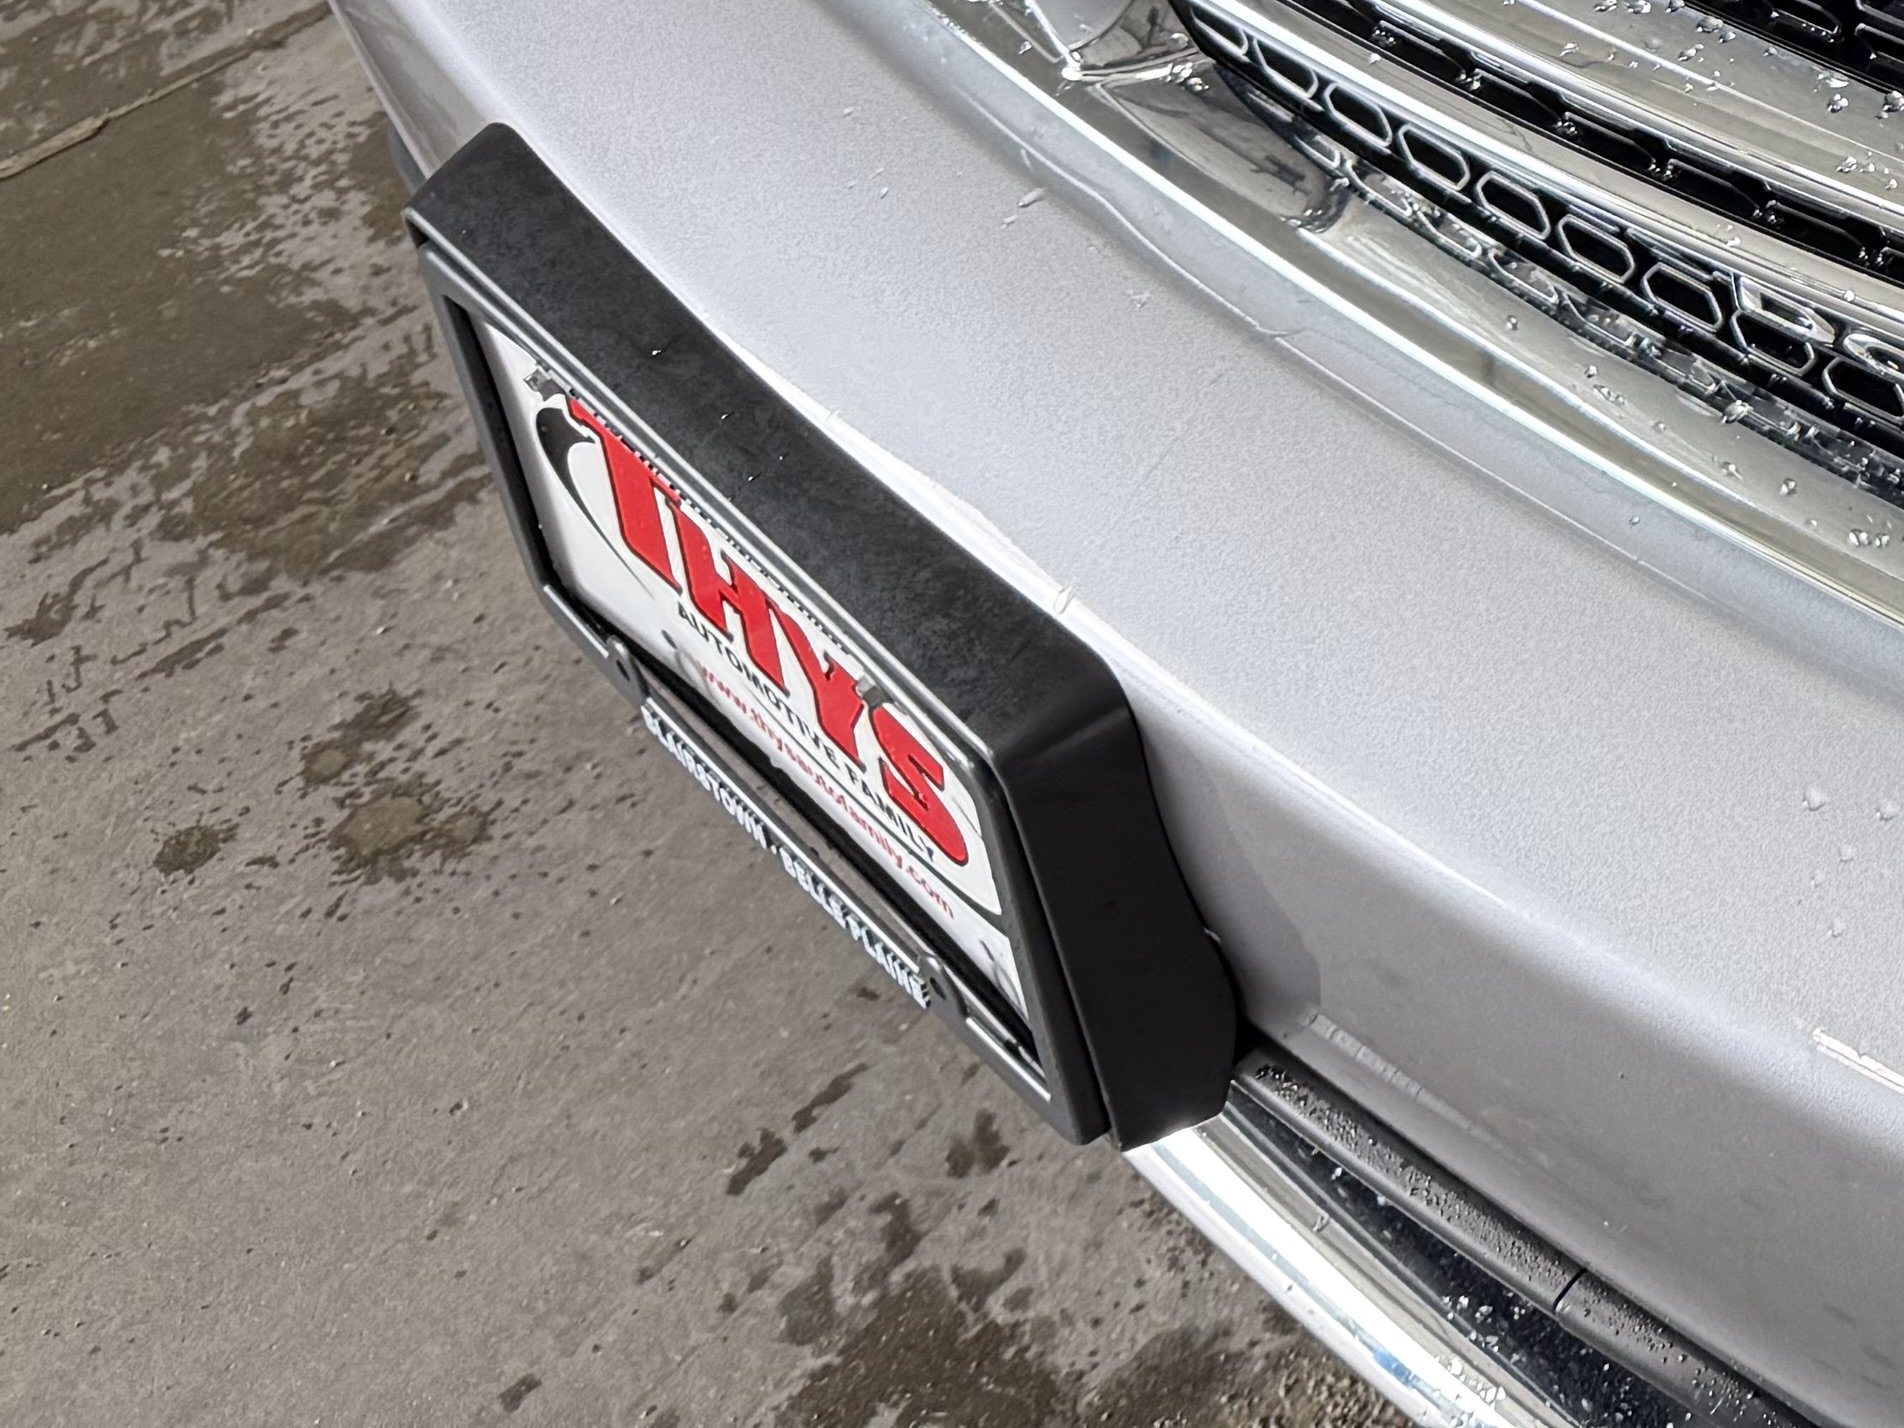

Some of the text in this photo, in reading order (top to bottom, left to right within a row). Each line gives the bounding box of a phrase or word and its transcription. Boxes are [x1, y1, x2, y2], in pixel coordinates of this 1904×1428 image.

[567, 396, 969, 867] THYS
[677, 599, 934, 862] AUTOMOTIVE FAMILY
[701, 663, 955, 920] www.thysautofamily.com
[778, 846, 849, 929] BELLE
[844, 914, 932, 1010] PLAINE
